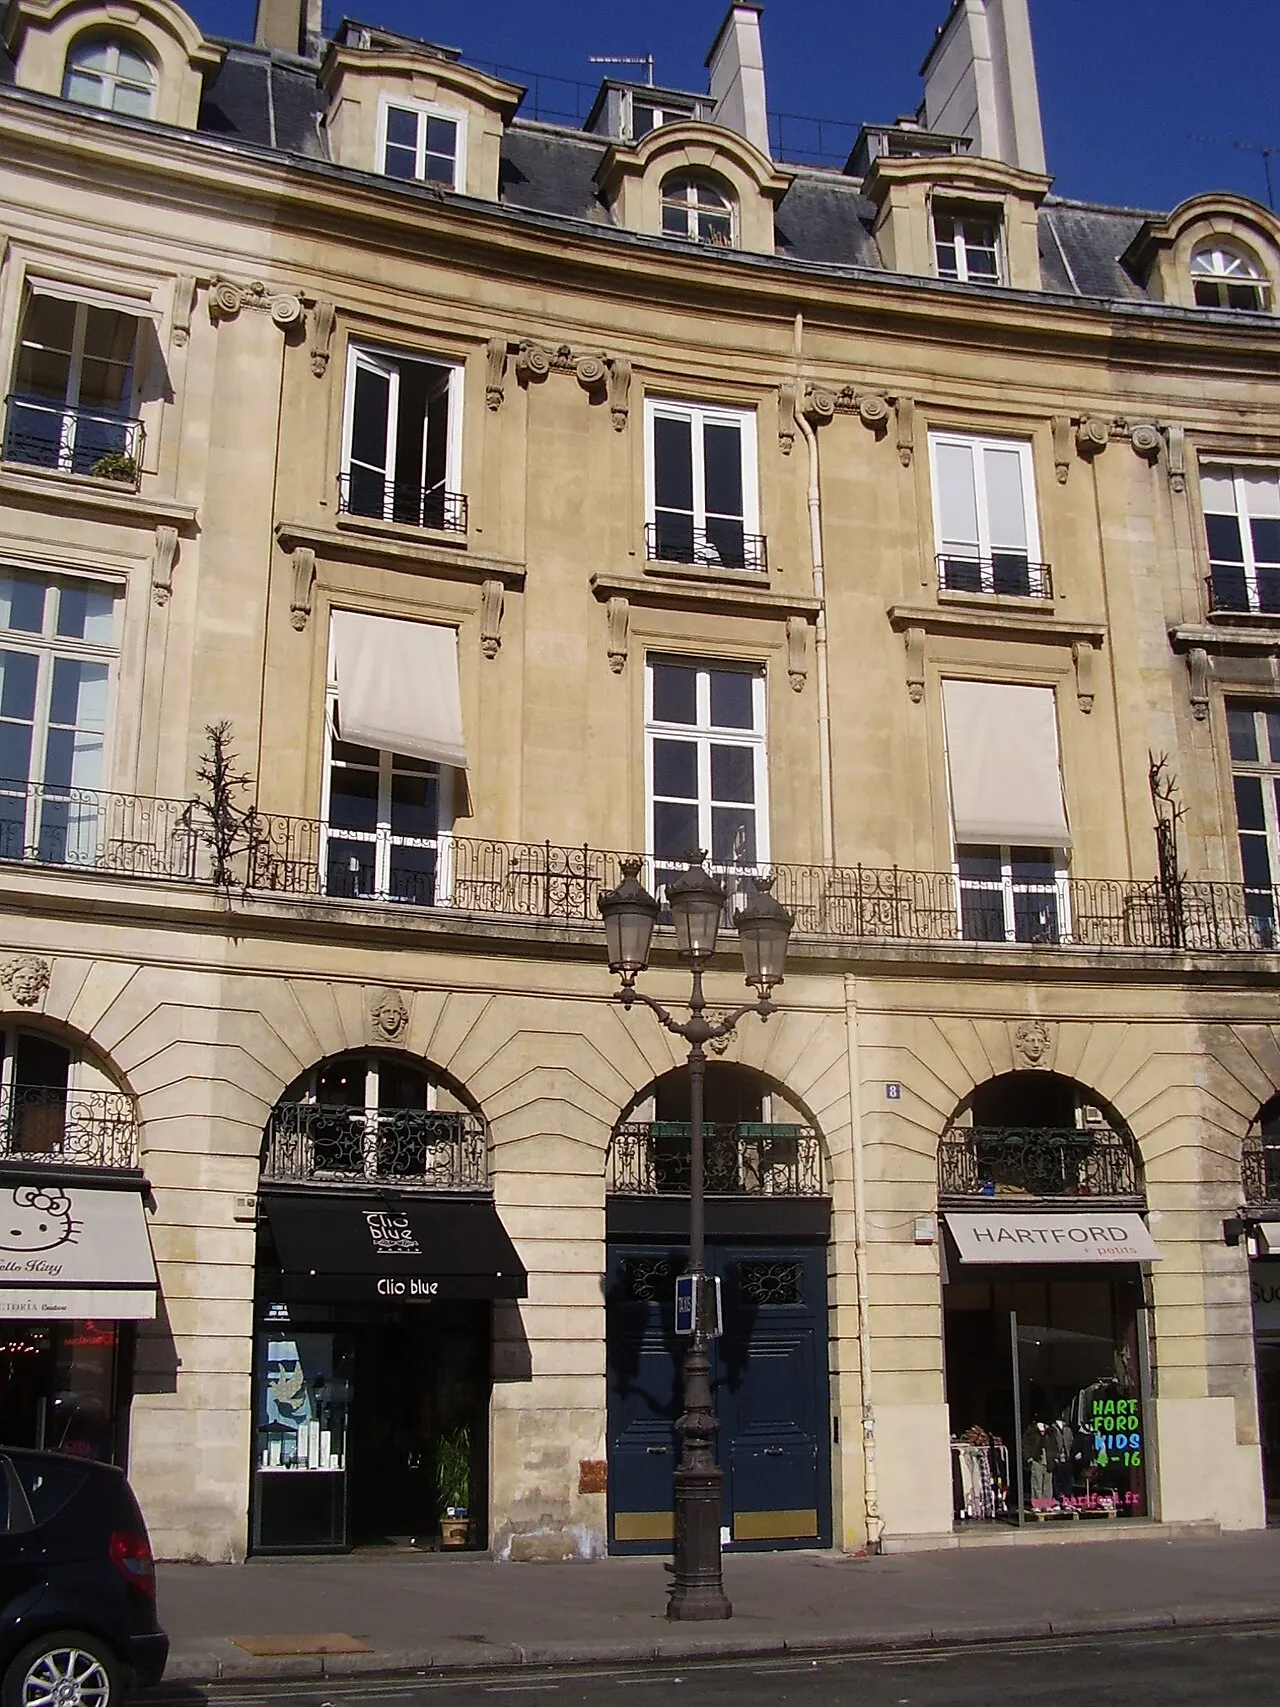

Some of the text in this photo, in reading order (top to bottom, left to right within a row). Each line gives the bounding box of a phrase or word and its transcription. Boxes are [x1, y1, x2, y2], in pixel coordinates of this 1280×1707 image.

[889, 1085, 897, 1098] 8
[366, 1214, 409, 1228] Clio
[369, 1226, 412, 1240] blue
[972, 1226, 1128, 1244] HARTFORD
[0, 1259, 63, 1276] ello Kitty
[377, 1279, 438, 1295] Clio blue
[1092, 1399, 1138, 1415] HART
[1094, 1415, 1139, 1431] FORD
[1094, 1433, 1140, 1451] KIDS
[1097, 1451, 1141, 1467] 4-16
